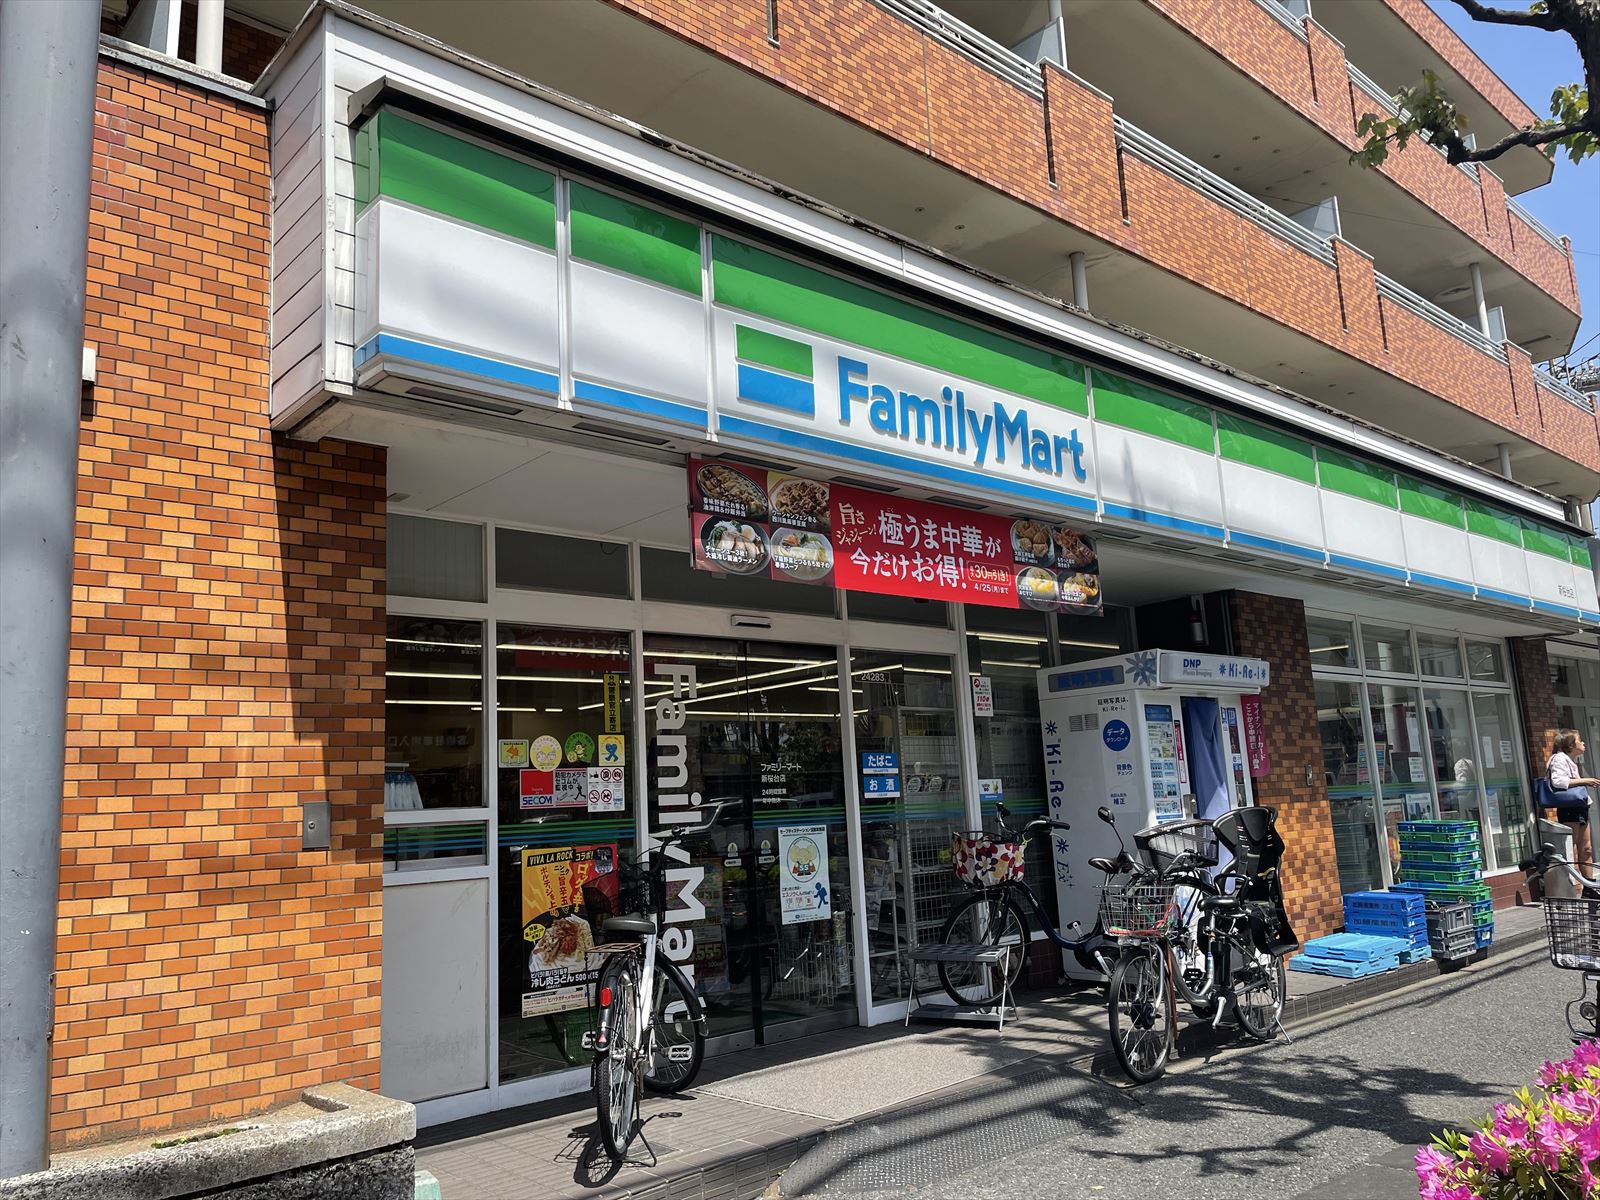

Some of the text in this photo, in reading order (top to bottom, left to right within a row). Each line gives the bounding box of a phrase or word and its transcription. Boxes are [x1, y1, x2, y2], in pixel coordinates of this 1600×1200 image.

[837, 355, 1086, 483] FamilyMart
[838, 502, 865, 525] 旨さ
[879, 510, 1001, 558] 極うま中華が
[850, 547, 967, 589] 今だけお得!
[1183, 658, 1201, 668] DNP
[861, 672, 885, 682] 24283
[1228, 663, 1260, 679] Ki-Re-i
[1107, 727, 1125, 736] データ
[760, 762, 802, 772] ファミリーマート
[868, 754, 893, 767] たばこ
[555, 771, 586, 779] 防犯カメラで
[869, 779, 895, 791] お酒
[1046, 743, 1065, 824] Ki-Re-
[522, 795, 552, 806] SECOM
[529, 851, 594, 866] VIVA LA ROCK コラボ!
[530, 973, 574, 988] 冷し肉うどん
